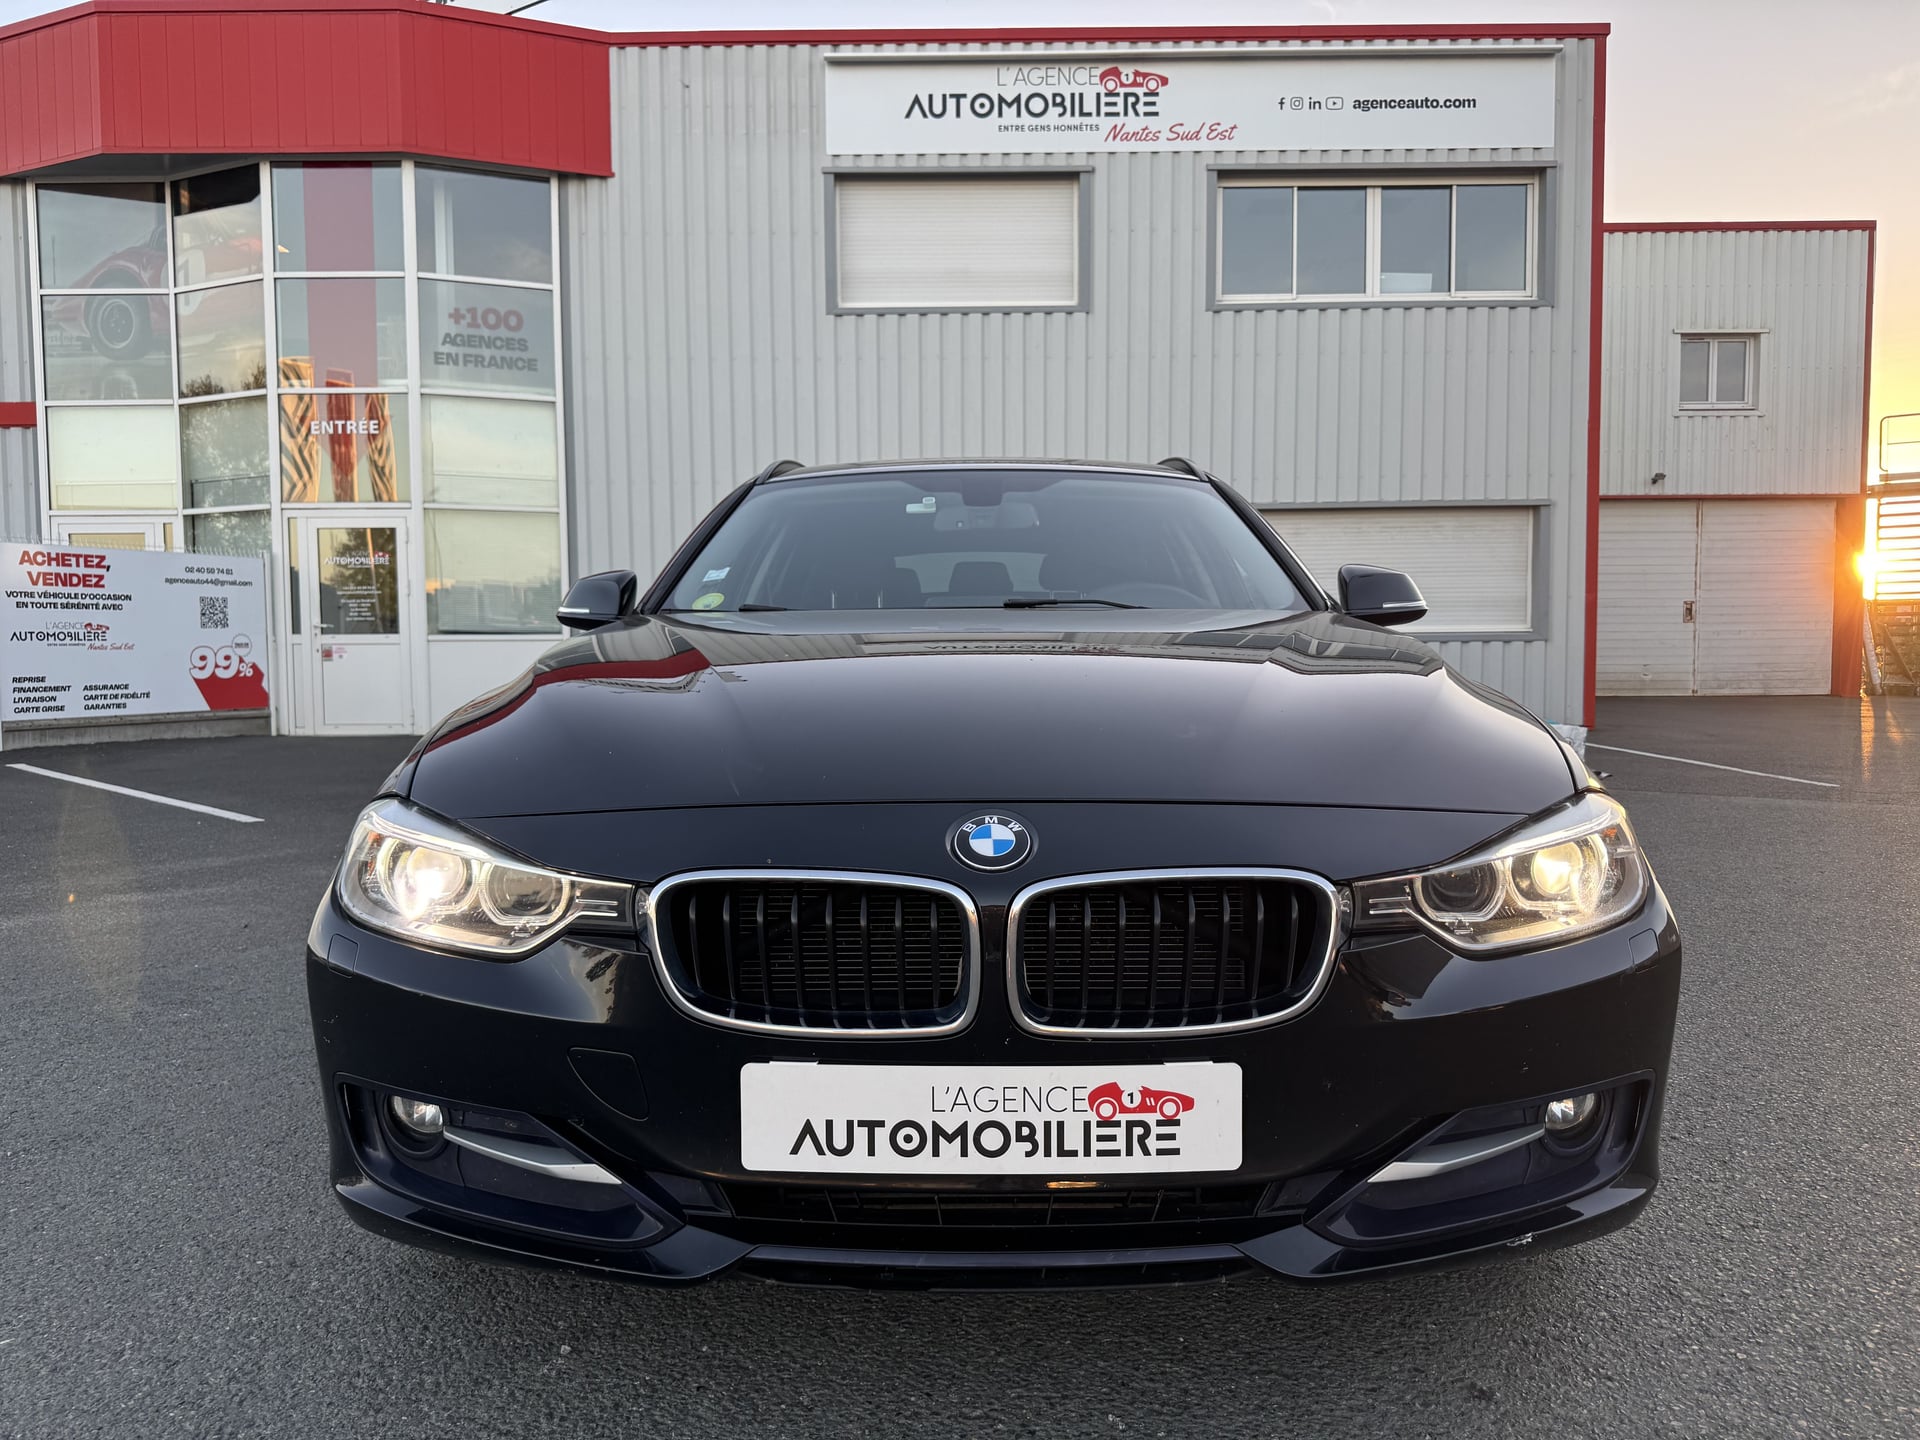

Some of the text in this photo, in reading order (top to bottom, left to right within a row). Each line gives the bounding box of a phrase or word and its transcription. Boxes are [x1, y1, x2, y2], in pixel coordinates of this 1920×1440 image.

[997, 66, 1099, 87] L'AGENCE
[904, 92, 1160, 118] AUTOMOBILIERE
[1352, 97, 1477, 112] agenceauto.com
[998, 122, 1100, 133] ENTRE GENS HONNÊTES
[1104, 122, 1239, 143] Nantes Sud Est
[448, 307, 524, 333] +100
[441, 333, 530, 352] AGENCES
[433, 351, 539, 372] EN FRANCE
[310, 417, 380, 435] ENTRÉE
[19, 550, 111, 572] ACHETEZ,
[27, 571, 106, 589] VENDEZ
[5, 590, 132, 602] VOTRE VÉHICULE D'OCCASION
[16, 601, 124, 611] EN TOUTE SÉRÉNITÉ AVEC
[45, 621, 85, 631] L'AGENCE
[12, 676, 47, 684] REPRISE
[82, 683, 130, 692] ASSURANCE
[12, 685, 72, 694] FINANCEMENT
[83, 691, 151, 701] CARTE DE FIDÉLITÉ
[13, 695, 57, 704] LIVRAISON
[84, 702, 127, 711] GARANTIES
[14, 705, 66, 714] CARTE GRISE
[962, 816, 1022, 833] BMW
[931, 1086, 1088, 1113] L'AGENCE
[789, 1118, 1181, 1158] AUTOMOBILIERE
